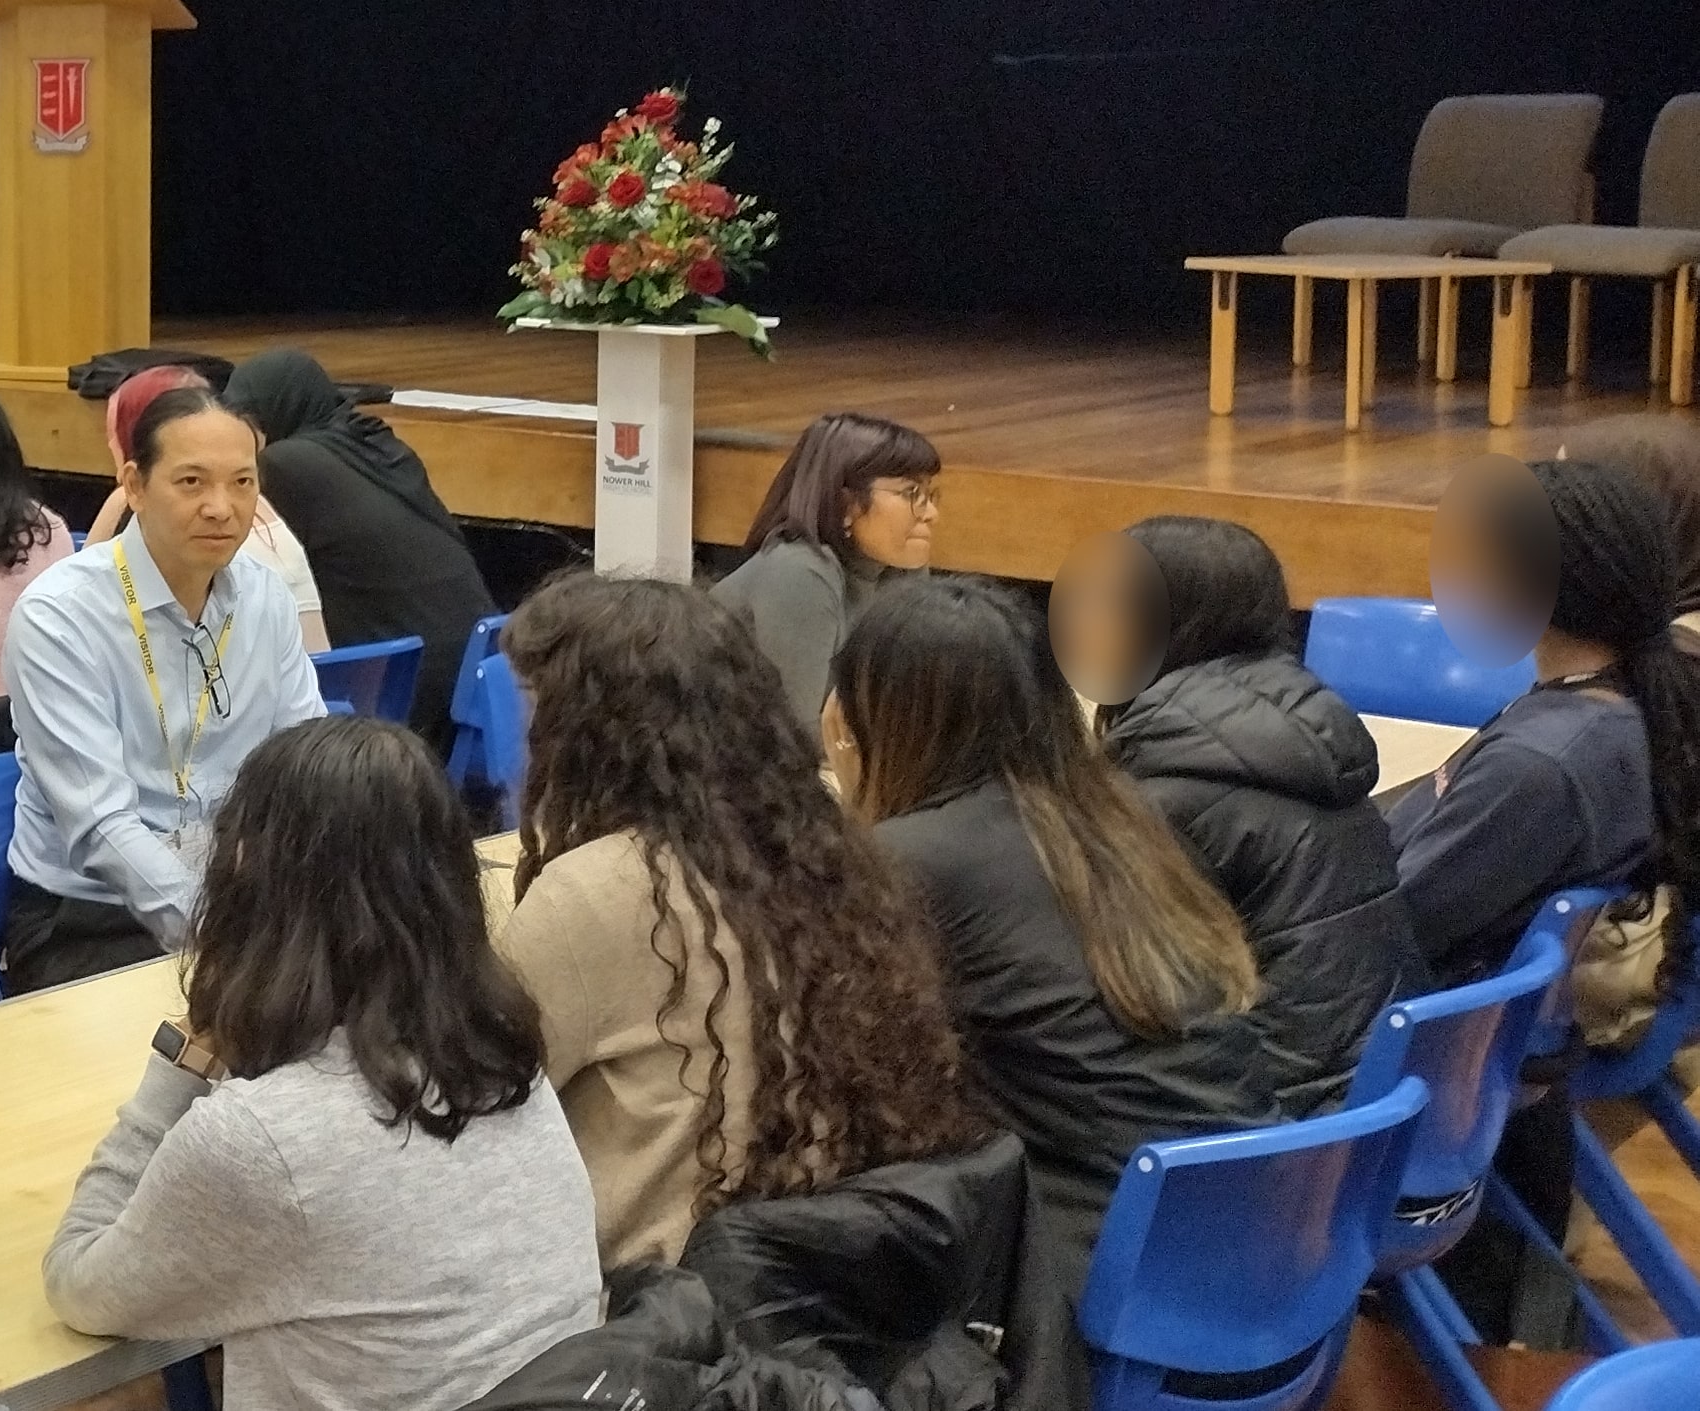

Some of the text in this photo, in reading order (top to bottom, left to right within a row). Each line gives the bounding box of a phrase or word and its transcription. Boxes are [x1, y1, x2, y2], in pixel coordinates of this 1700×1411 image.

[603, 476, 652, 489] NOWER HILL
[119, 565, 137, 605] VISITOR
[138, 633, 155, 675] VISITOR
